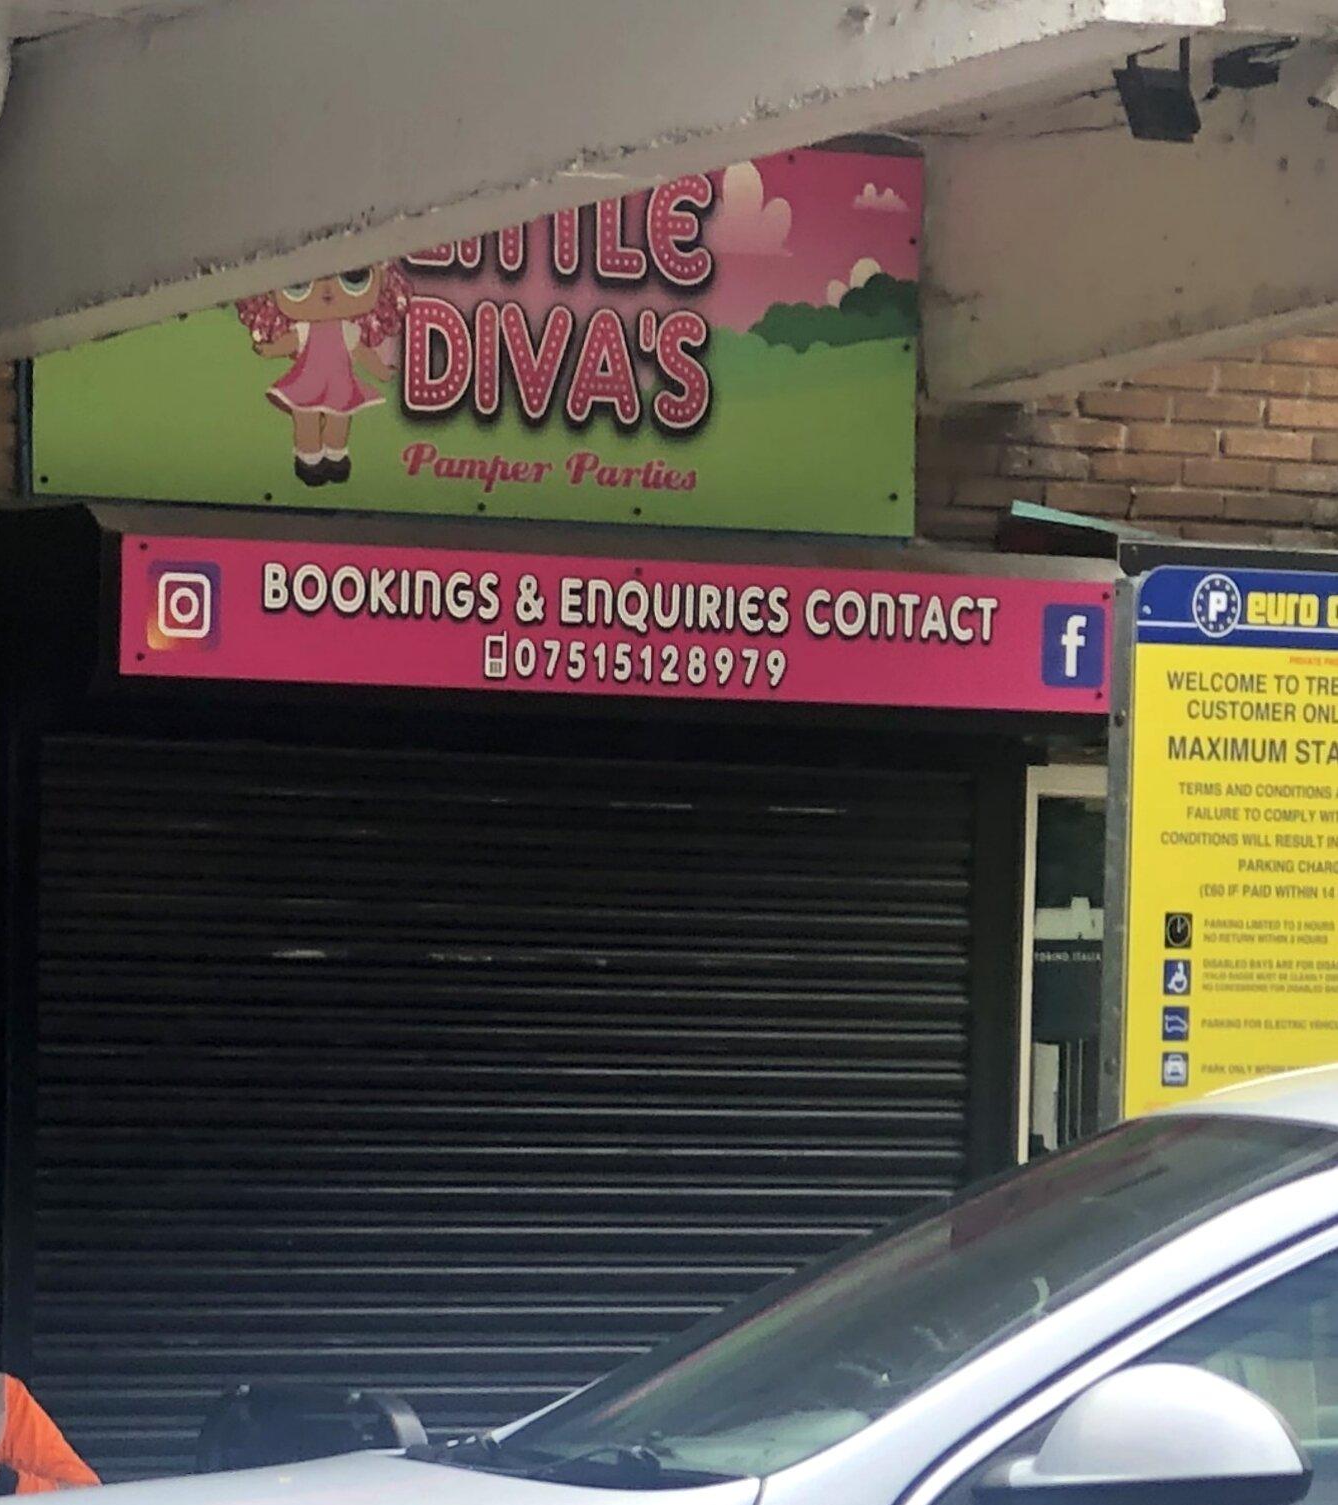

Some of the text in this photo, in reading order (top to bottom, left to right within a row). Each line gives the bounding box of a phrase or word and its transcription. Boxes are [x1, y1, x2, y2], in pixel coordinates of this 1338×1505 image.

[404, 296, 710, 429] DIVA'S
[402, 442, 698, 493] Pamper Parties
[262, 562, 998, 643] BOOKINGS & ENQUIRIES CONTACT
[1247, 591, 1319, 627] euro
[513, 637, 787, 688] 07515128979
[1167, 671, 1267, 694] WELCOME
[1275, 675, 1300, 695] TO
[1187, 700, 1296, 723] CUSTOMER
[1167, 735, 1287, 765] MAXIMUM
[1179, 781, 1332, 799] TERMS AND CONDITIONS
[1186, 806, 1240, 821] FAILURE
[1244, 807, 1261, 821] TO
[1264, 808, 1317, 823] COMPLY
[1160, 831, 1239, 846] CONDITIONS
[1242, 833, 1272, 847] WILL
[1275, 834, 1324, 849] RESULT
[1238, 858, 1294, 873] PARKING
[1243, 884, 1272, 898] PAID
[1275, 885, 1318, 899] WITHIN
